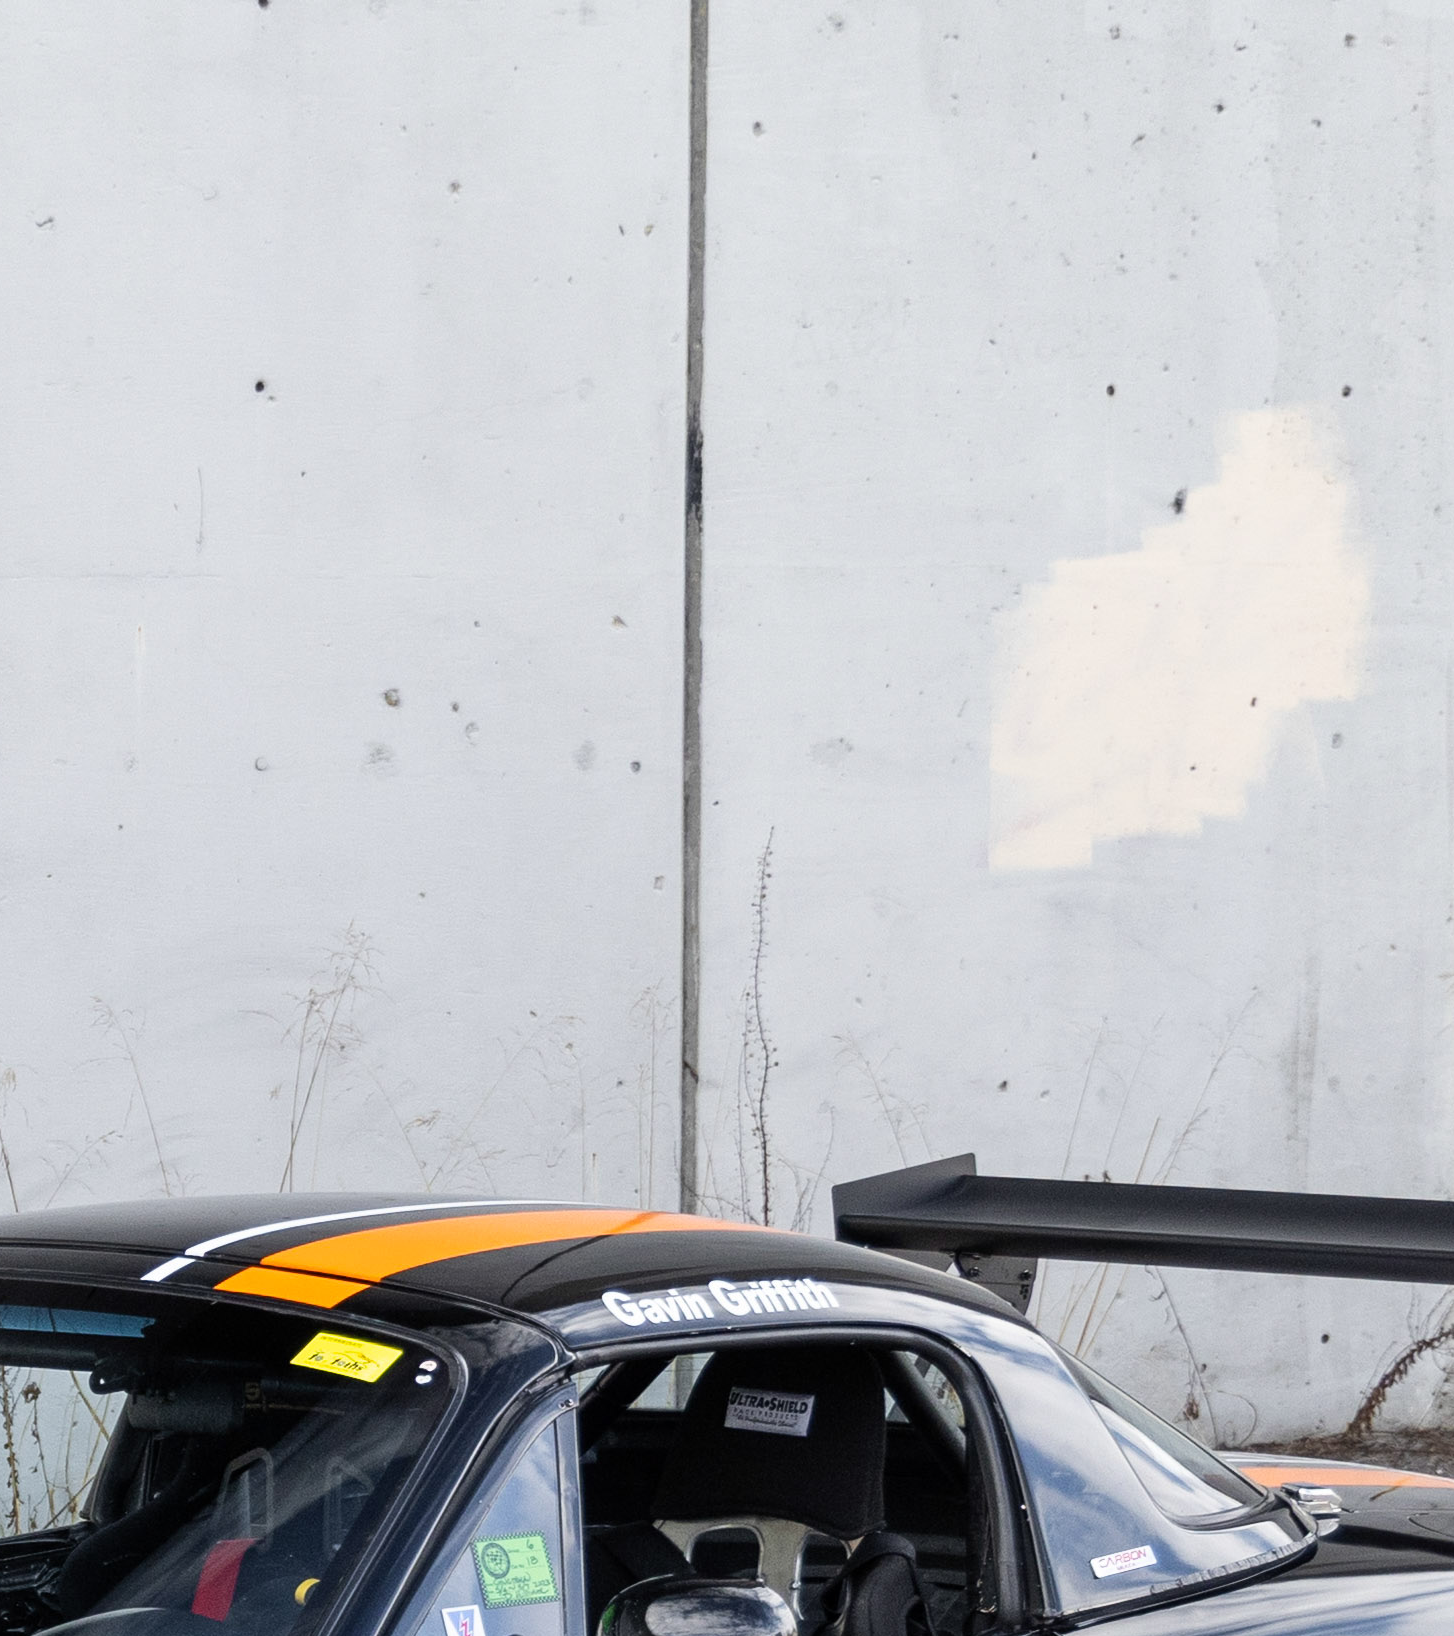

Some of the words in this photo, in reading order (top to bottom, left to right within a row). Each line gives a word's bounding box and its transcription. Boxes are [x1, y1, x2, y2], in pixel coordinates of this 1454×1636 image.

[601, 1289, 715, 1327] Gavin
[707, 1278, 841, 1317] Griffith
[1098, 1548, 1147, 1569] CARBON
